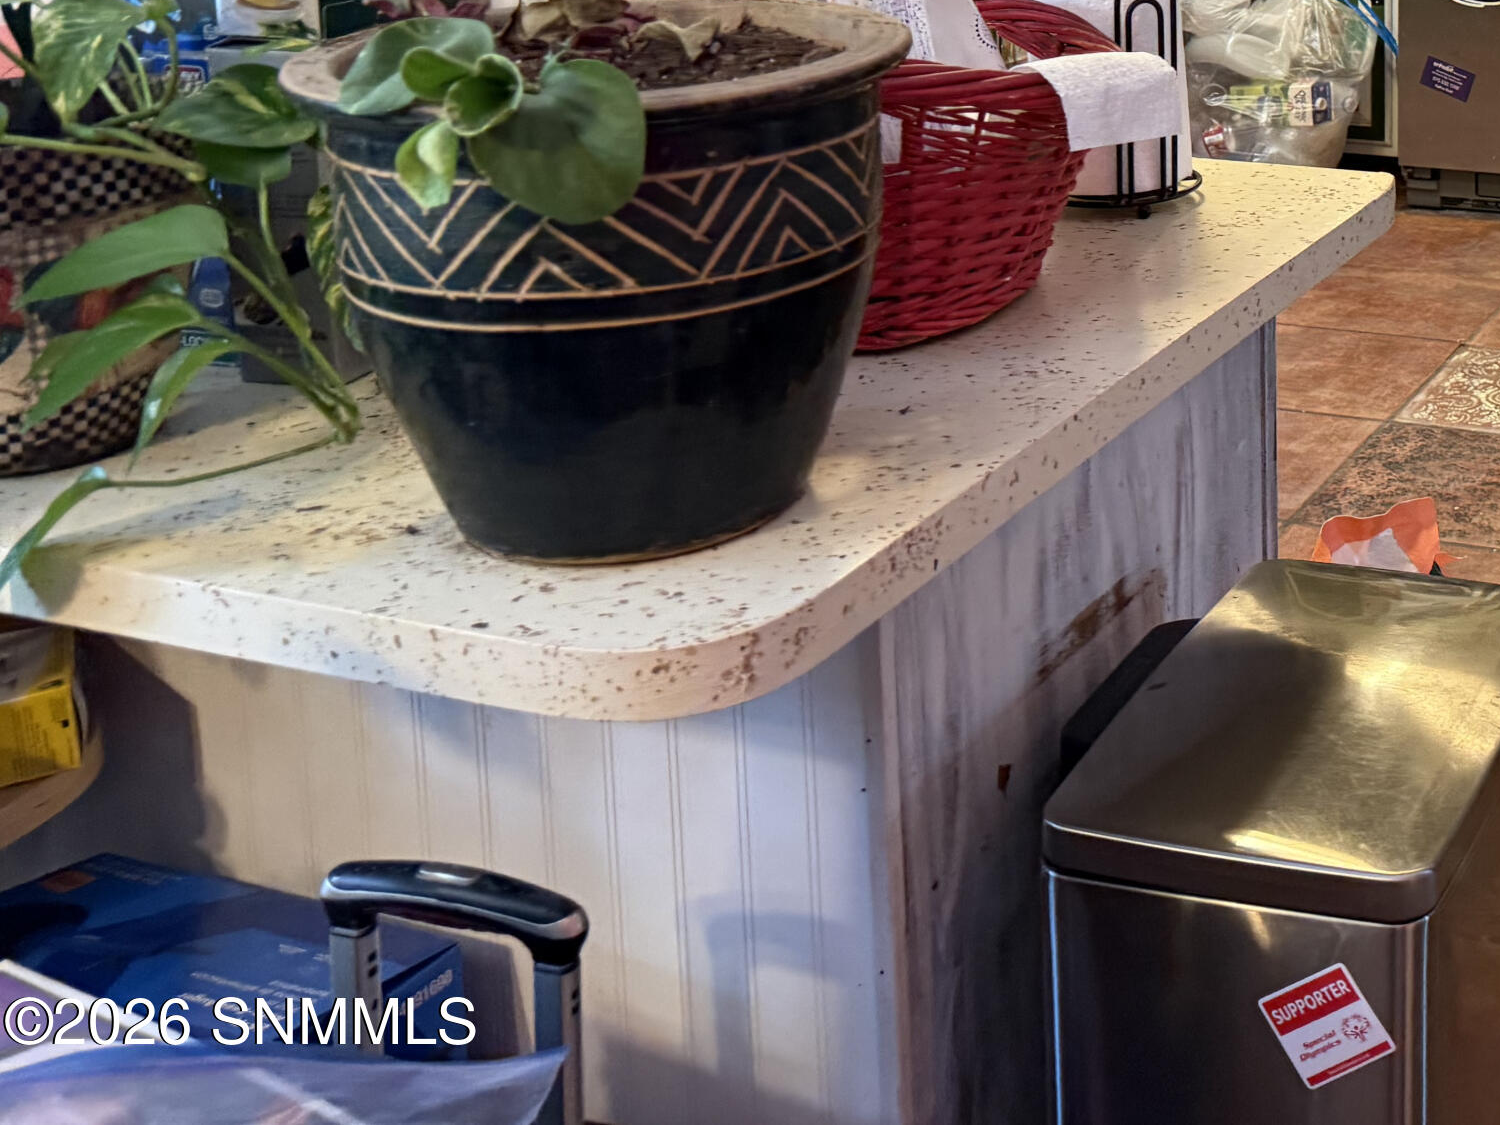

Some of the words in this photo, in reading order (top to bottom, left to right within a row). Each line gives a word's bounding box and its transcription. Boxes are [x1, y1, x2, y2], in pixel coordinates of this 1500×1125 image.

[1271, 979, 1351, 1025] SUPPORTER
[1300, 1039, 1342, 1062] Olympics
[1303, 1029, 1337, 1049] Special
